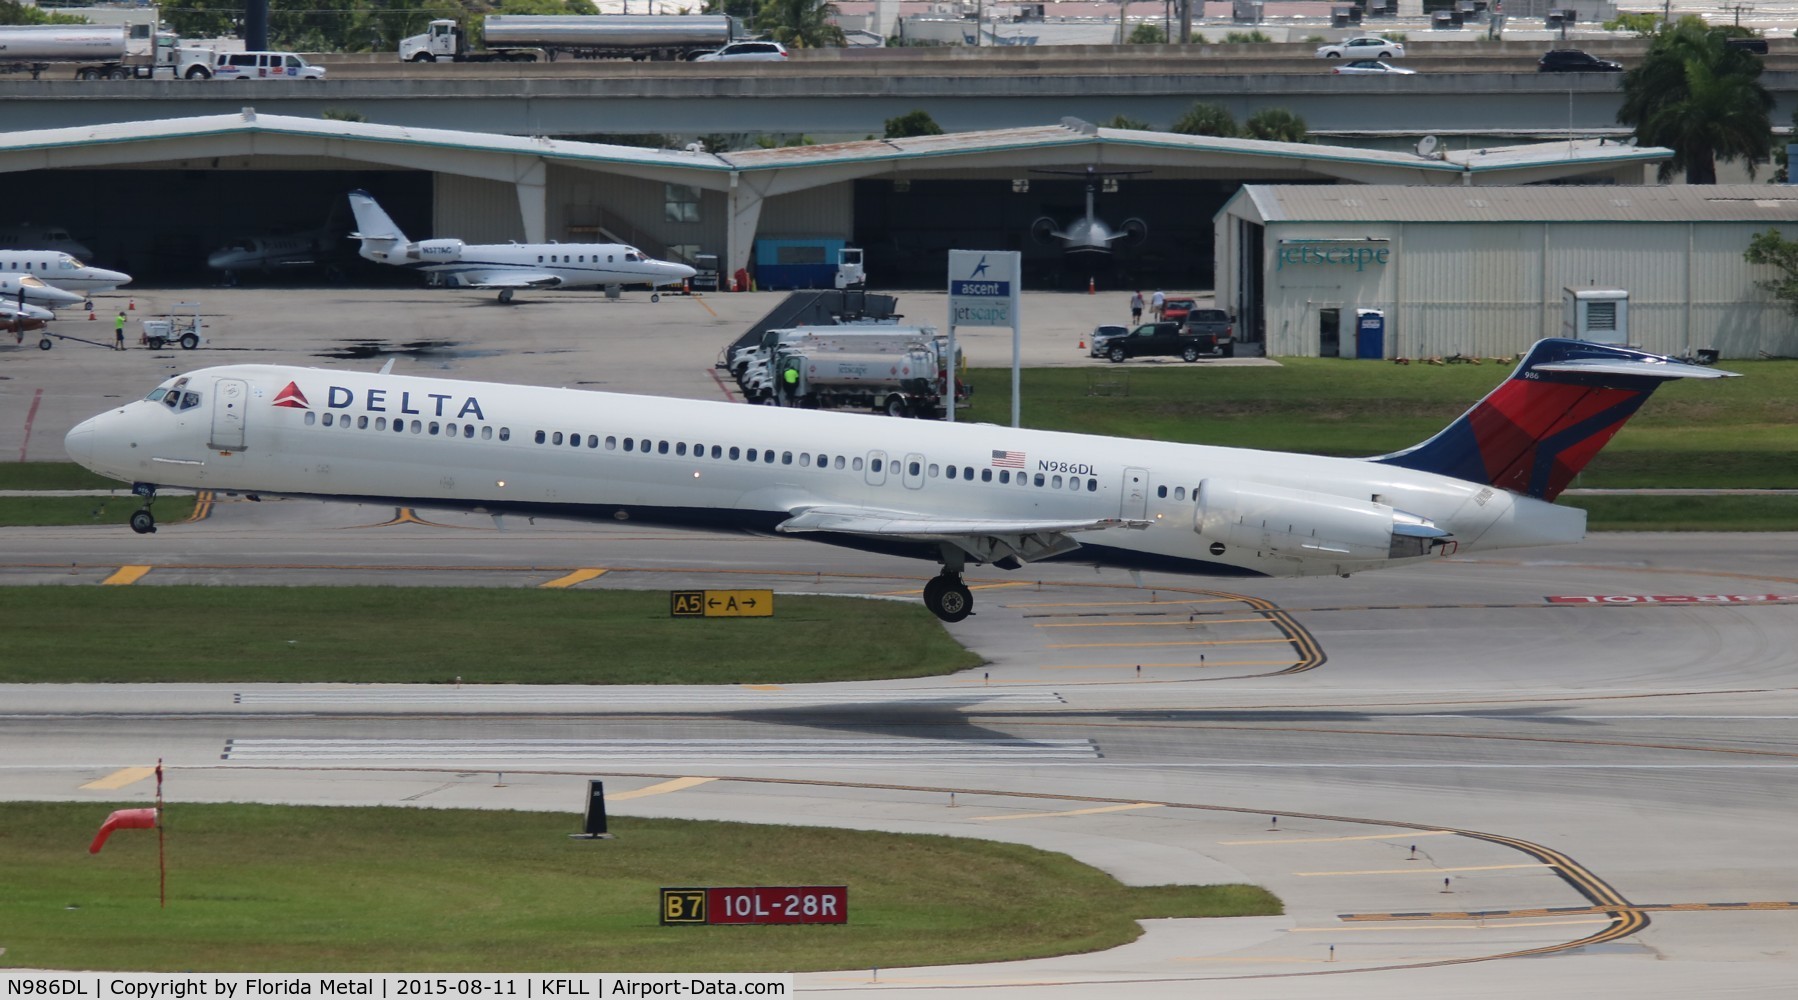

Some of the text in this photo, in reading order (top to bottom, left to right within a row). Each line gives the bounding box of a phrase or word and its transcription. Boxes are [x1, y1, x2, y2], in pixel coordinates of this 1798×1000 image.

[1276, 245, 1390, 272] jetscape
[961, 283, 999, 295] ascent
[953, 301, 1007, 325] jetscape
[1524, 371, 1540, 380] 986
[328, 386, 484, 420] DELTA
[1038, 459, 1098, 476] N986DL
[675, 595, 739, 612] A5 A
[667, 894, 838, 917] B7 10L-28R
